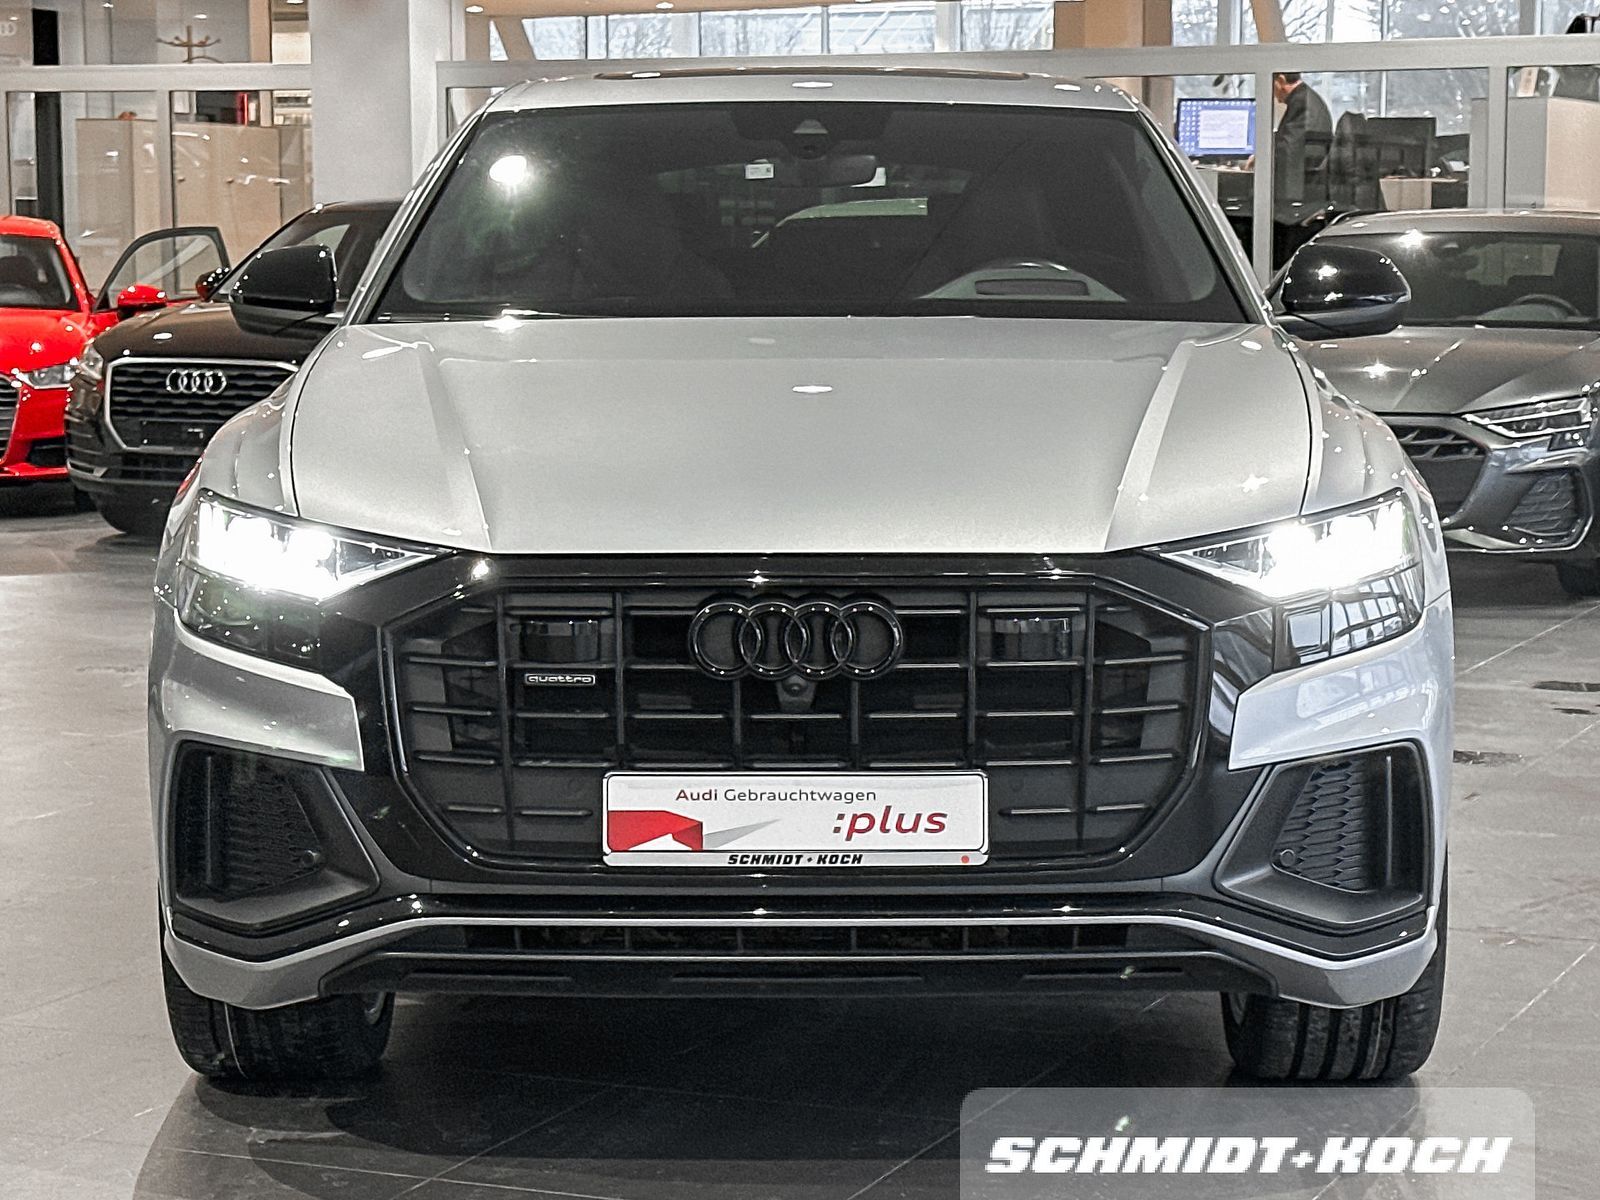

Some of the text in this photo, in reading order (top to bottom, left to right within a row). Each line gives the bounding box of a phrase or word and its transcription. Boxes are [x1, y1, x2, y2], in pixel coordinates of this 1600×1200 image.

[527, 675, 593, 683] quattro
[676, 789, 877, 804] Audi Gebrauchtwagen
[728, 854, 803, 865] SCHMIDT
[816, 854, 863, 865] KOCH
